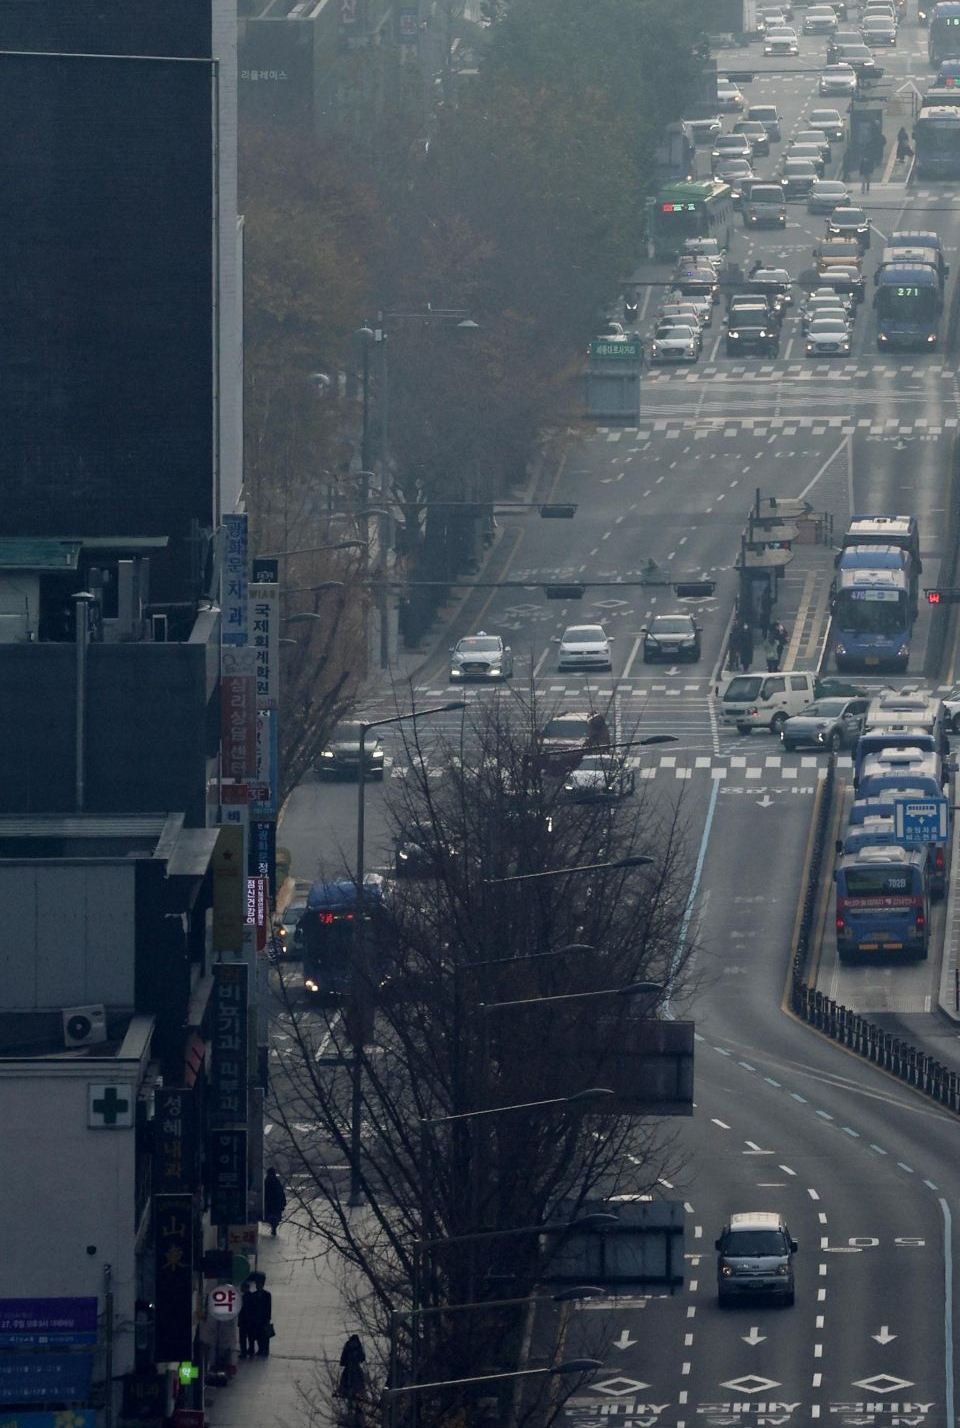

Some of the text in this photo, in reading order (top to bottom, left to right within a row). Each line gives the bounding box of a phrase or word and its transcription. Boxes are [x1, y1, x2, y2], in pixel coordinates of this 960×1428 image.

[897, 287, 919, 297] 271
[253, 603, 271, 695] 국제회계학원
[161, 1214, 188, 1272] 山東
[212, 1290, 236, 1313] 약
